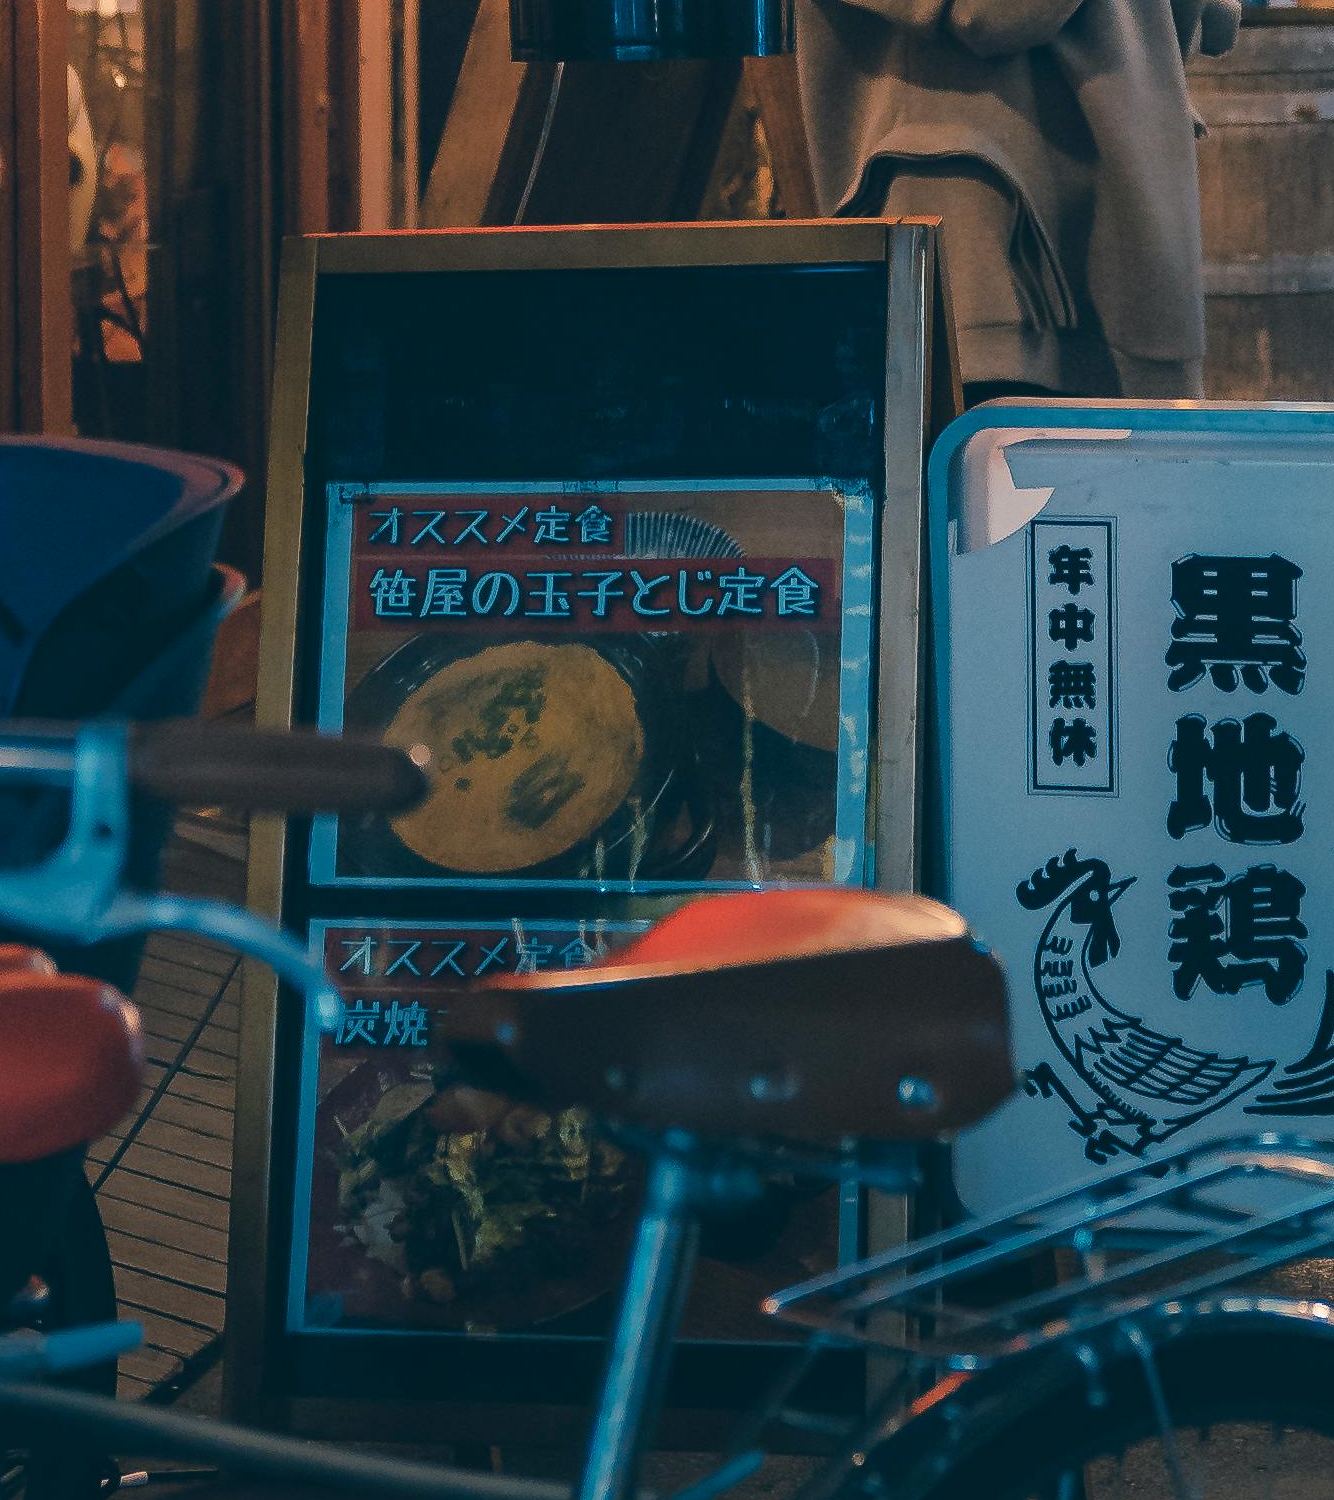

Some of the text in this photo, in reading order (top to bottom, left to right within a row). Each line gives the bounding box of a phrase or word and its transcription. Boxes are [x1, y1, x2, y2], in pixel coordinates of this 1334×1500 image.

[368, 505, 613, 545] オススメ定食
[369, 566, 819, 618] 笹屋の玉子とじ定食
[1048, 543, 1097, 770] 年中無休
[1164, 551, 1309, 1007] 黒地鶏
